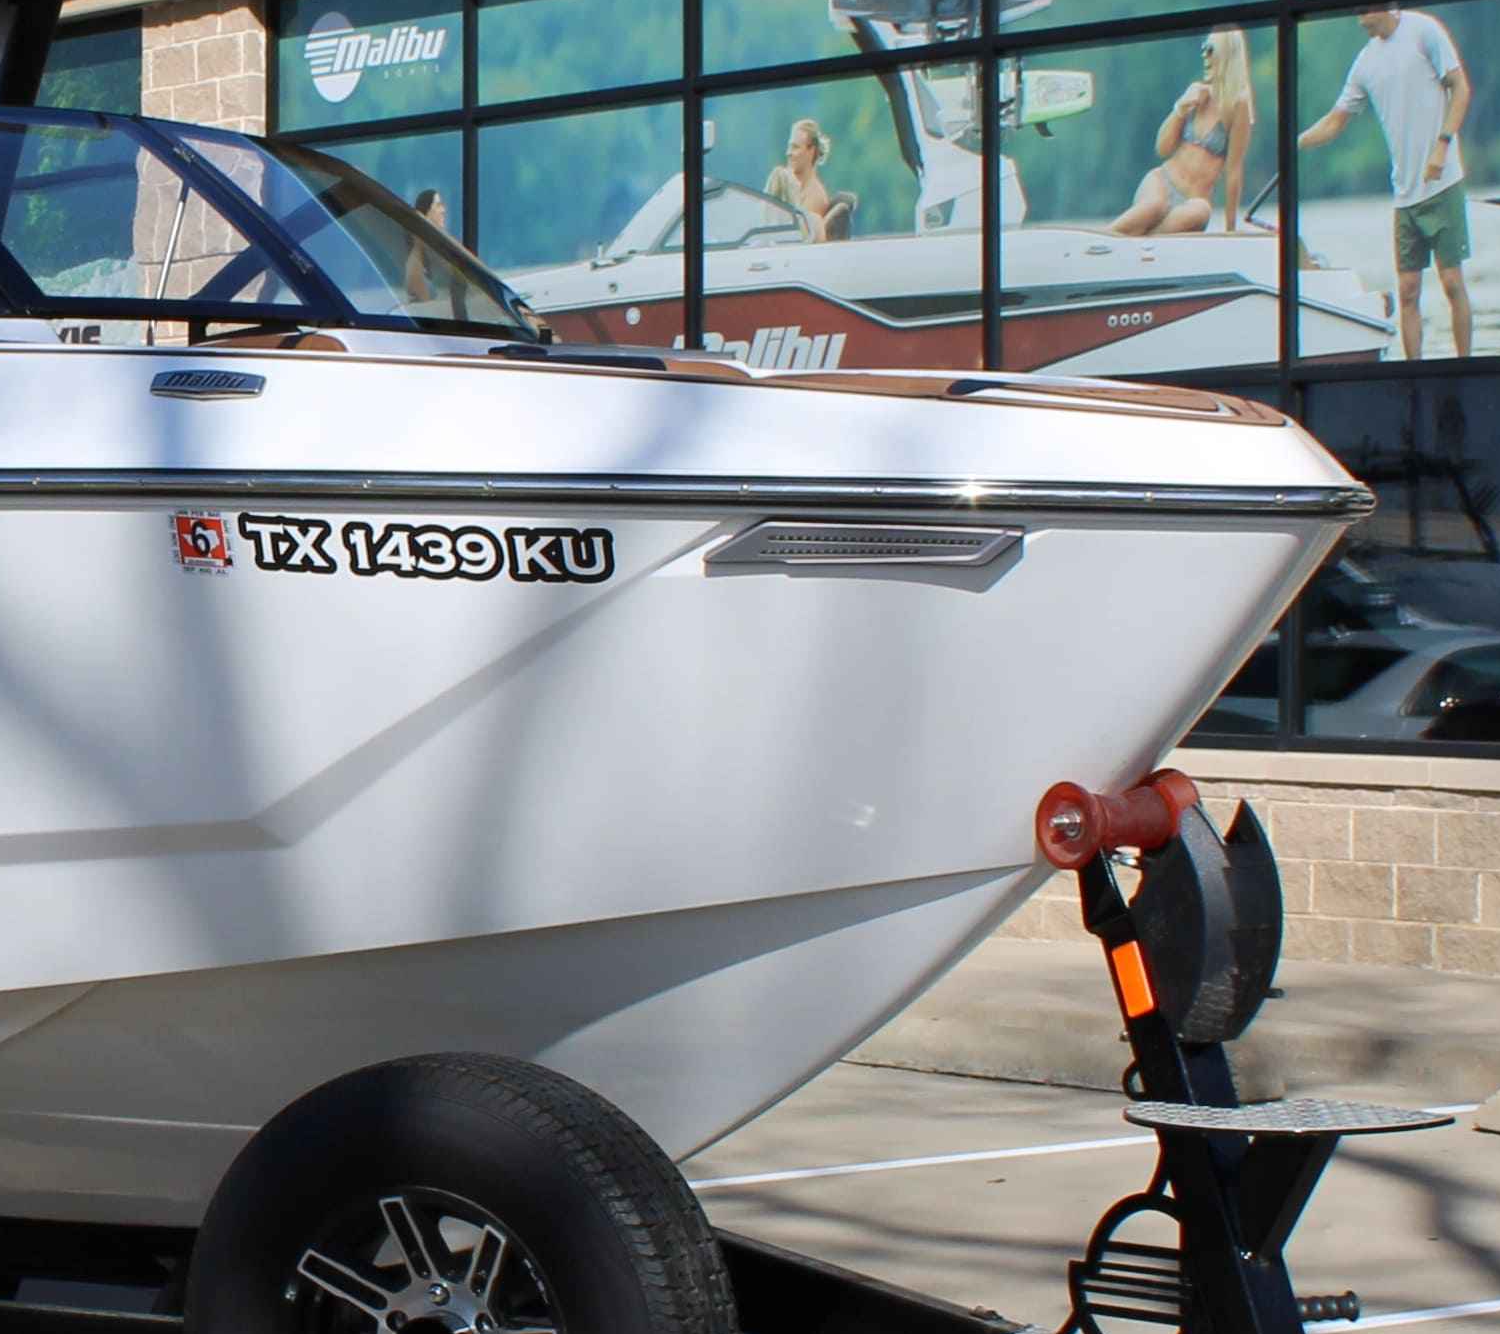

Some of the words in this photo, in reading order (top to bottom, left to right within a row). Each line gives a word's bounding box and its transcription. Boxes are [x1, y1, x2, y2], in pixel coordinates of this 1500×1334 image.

[332, 26, 446, 73] Malibu
[165, 372, 245, 388] Malibu
[192, 521, 211, 555] 6
[241, 516, 333, 571] TX
[346, 526, 499, 578] 1439
[509, 532, 609, 580] KU
